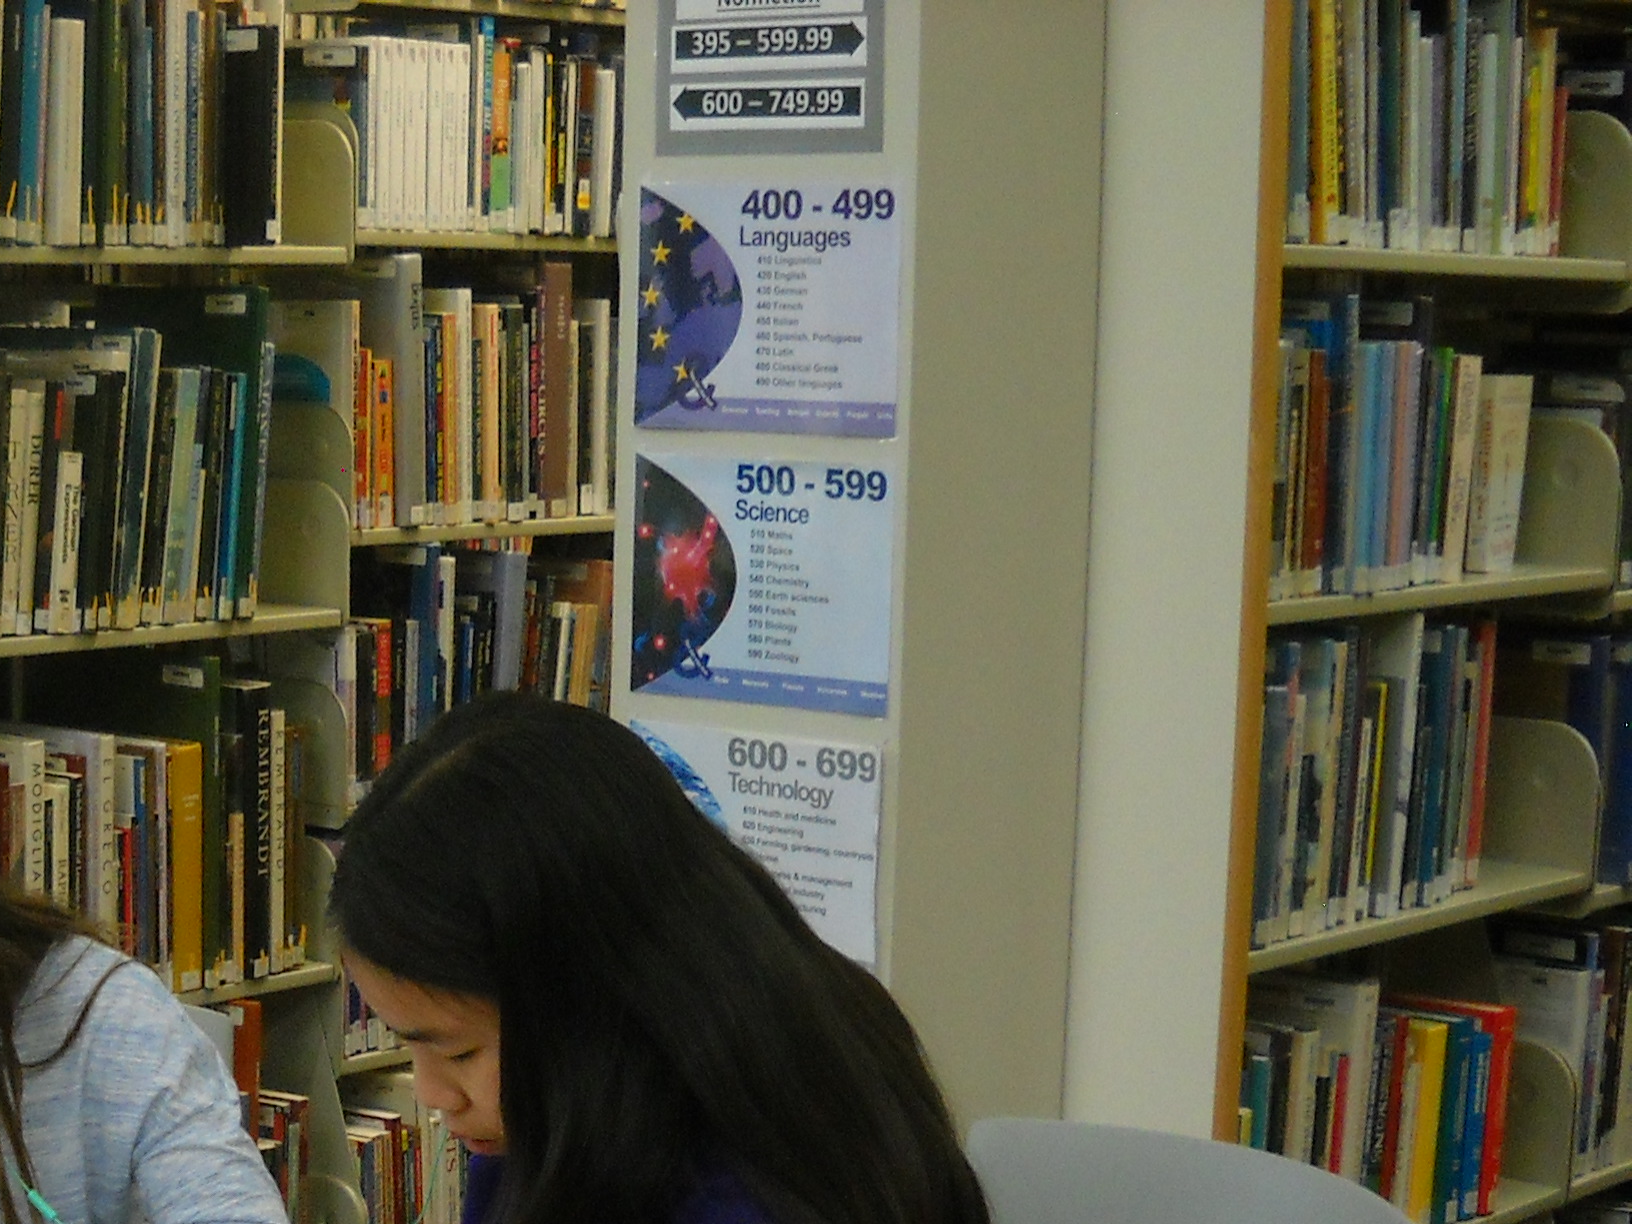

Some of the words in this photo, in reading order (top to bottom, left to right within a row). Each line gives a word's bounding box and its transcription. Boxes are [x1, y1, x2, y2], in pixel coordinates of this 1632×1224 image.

[691, 31, 730, 55] 395
[757, 27, 833, 52] 599.99
[702, 91, 742, 115] 600
[769, 89, 844, 114] 749.99
[741, 189, 802, 219] 400
[831, 189, 895, 220] 499
[739, 226, 851, 252] Languages
[774, 272, 806, 282] English
[774, 287, 808, 295] German
[773, 302, 803, 311] French
[812, 334, 863, 344] Portuguese
[537, 384, 547, 455] CIRCUS
[737, 464, 795, 496] 500
[825, 468, 887, 501] 599
[72, 485, 81, 506] The
[735, 500, 810, 524] Science
[61, 483, 73, 564] Expressionists
[70, 508, 80, 553] German
[767, 530, 793, 541] Maths
[767, 546, 793, 557] Space
[767, 560, 800, 573] Physics
[766, 575, 810, 588] Chemistry
[765, 591, 788, 602] Earth
[791, 594, 829, 604] sciences
[765, 606, 796, 617] Fossils
[765, 636, 792, 647] Plants
[764, 650, 800, 663] Zoology
[102, 757, 113, 784] EL
[727, 737, 787, 771] 600
[816, 747, 877, 782] 699
[257, 707, 270, 878] REMBRANDT
[728, 771, 834, 809] Technology
[275, 730, 284, 884] REMBRANDT
[758, 807, 782, 818] Health
[783, 811, 799, 822] and
[800, 813, 837, 826] medicine
[32, 762, 43, 890] MODIGLIA
[757, 821, 804, 839] Engineering
[102, 800, 113, 895] GRECO
[801, 874, 853, 888] management
